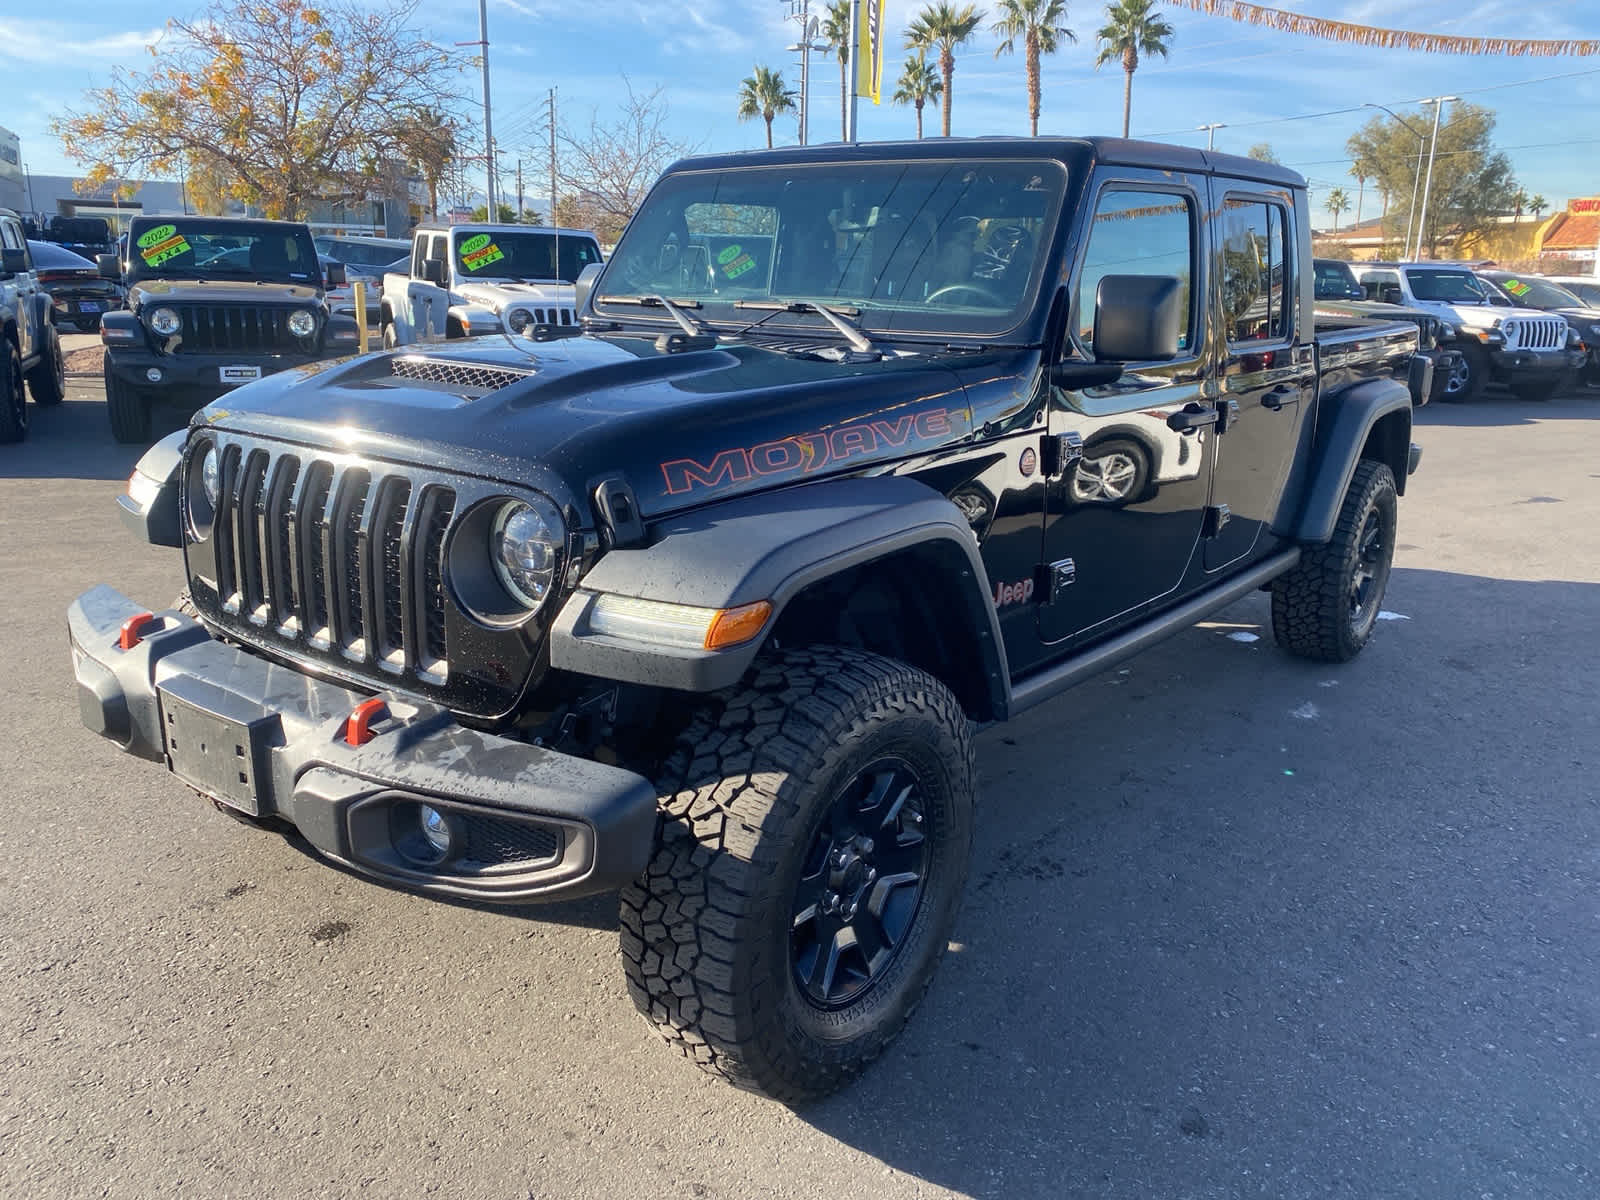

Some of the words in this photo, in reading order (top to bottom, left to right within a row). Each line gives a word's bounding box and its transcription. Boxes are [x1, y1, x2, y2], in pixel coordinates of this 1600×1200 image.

[144, 226, 170, 245] 2022
[464, 236, 486, 253] 2020
[660, 408, 950, 494] MOJAVE
[992, 578, 1034, 609] Jeep
